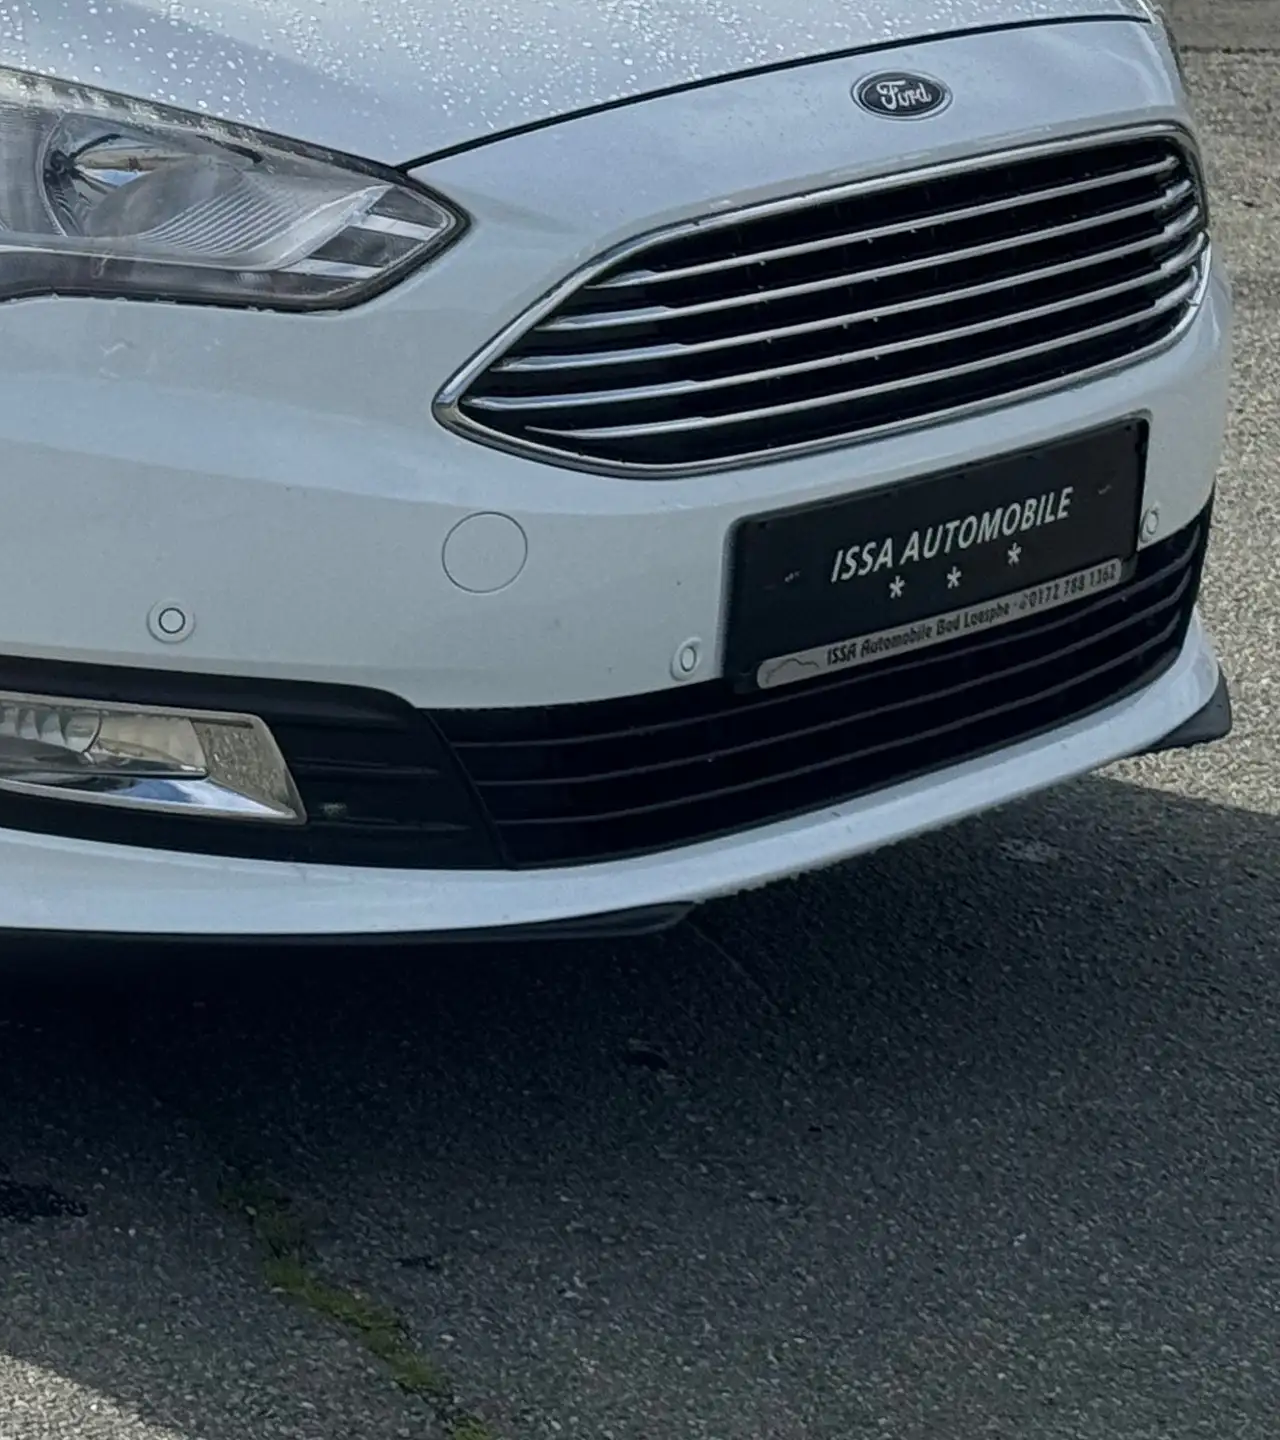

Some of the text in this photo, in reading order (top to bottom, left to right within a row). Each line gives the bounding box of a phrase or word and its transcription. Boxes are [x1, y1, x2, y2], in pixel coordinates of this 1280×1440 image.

[876, 79, 932, 109] Ford
[831, 486, 1074, 583] ISSA AUTOMOBILE
[827, 642, 857, 666] ISSA
